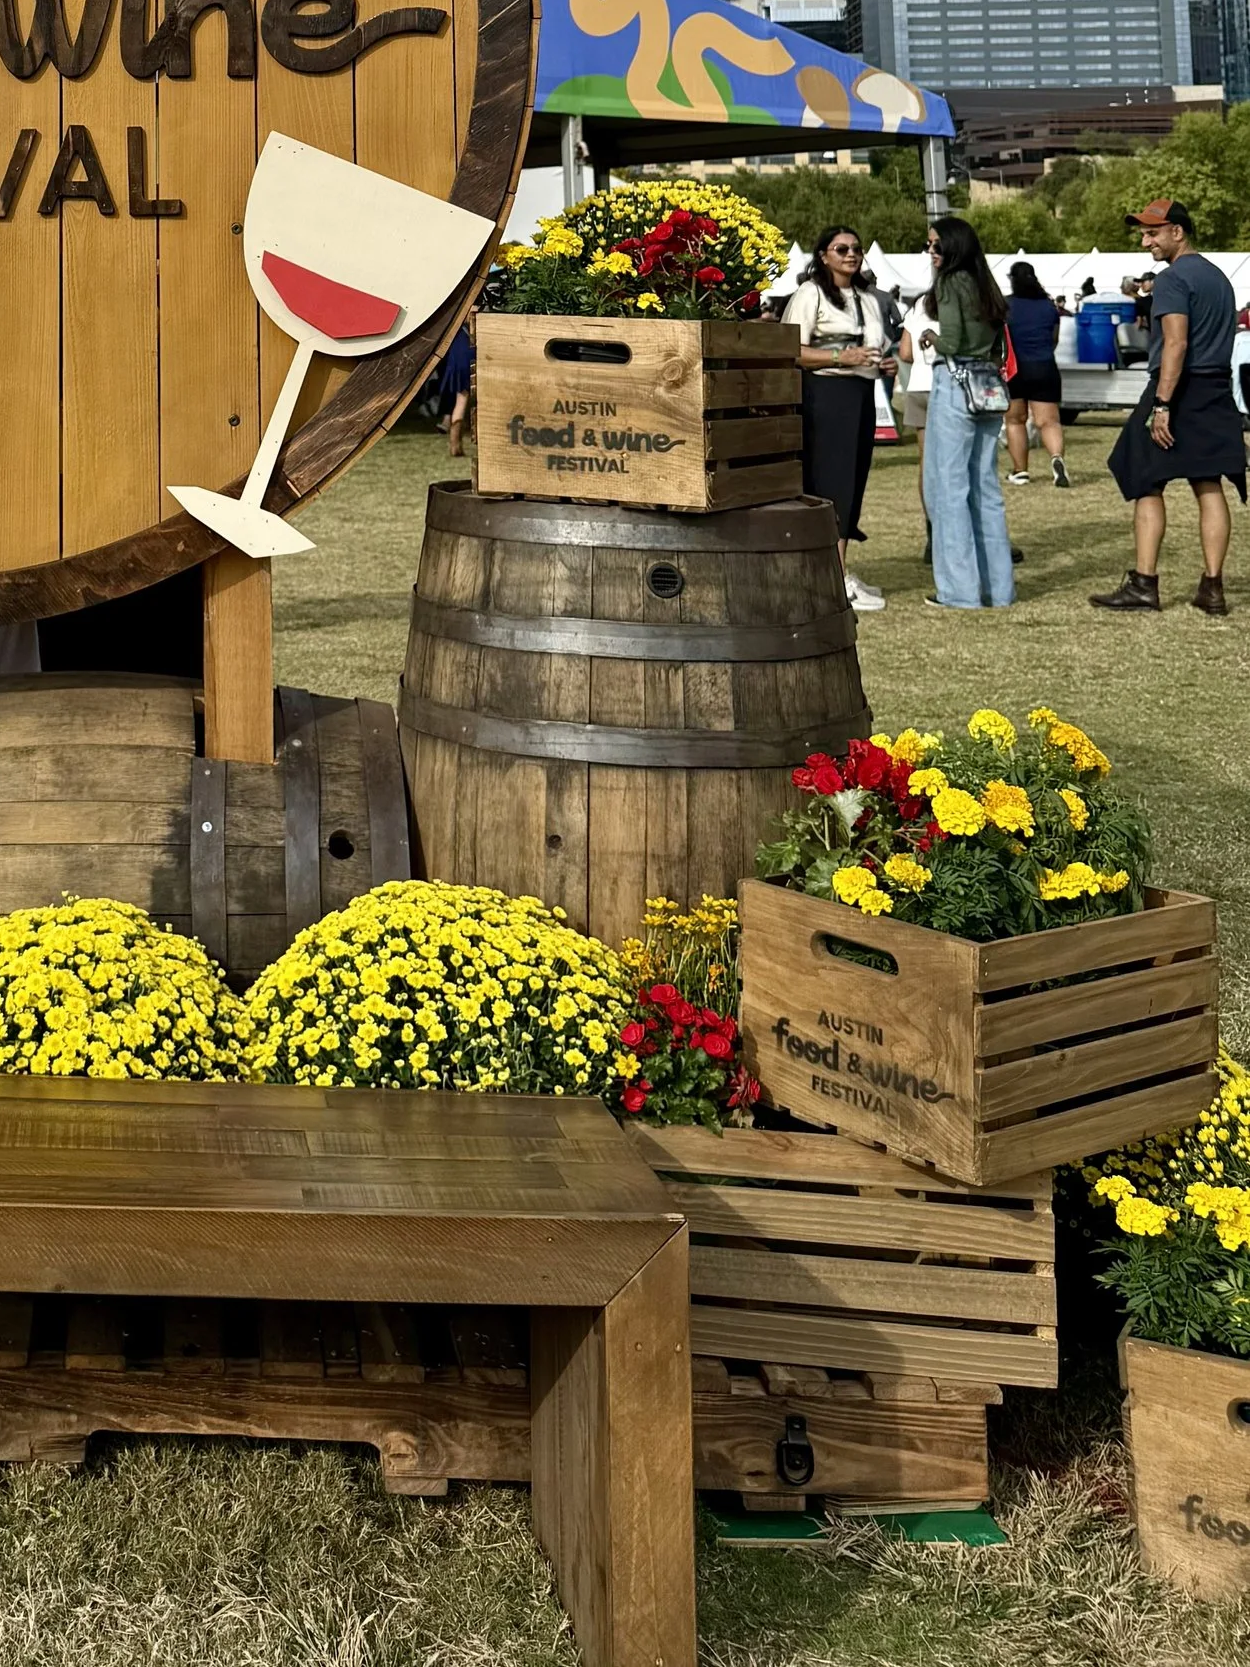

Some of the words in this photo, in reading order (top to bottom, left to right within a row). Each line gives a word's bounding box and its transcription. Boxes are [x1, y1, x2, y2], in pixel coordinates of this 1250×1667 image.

[552, 399, 617, 417] AUSTIN
[507, 414, 575, 449] food
[582, 428, 598, 447] &
[602, 426, 686, 453] wine
[547, 454, 630, 474] FESTIVAL
[818, 1010, 884, 1047] AUSTIN
[771, 1016, 840, 1072] food
[847, 1052, 863, 1076] &
[866, 1058, 955, 1104] wine
[811, 1074, 896, 1120] FESTIVAL
[1178, 1494, 1250, 1547] foo
